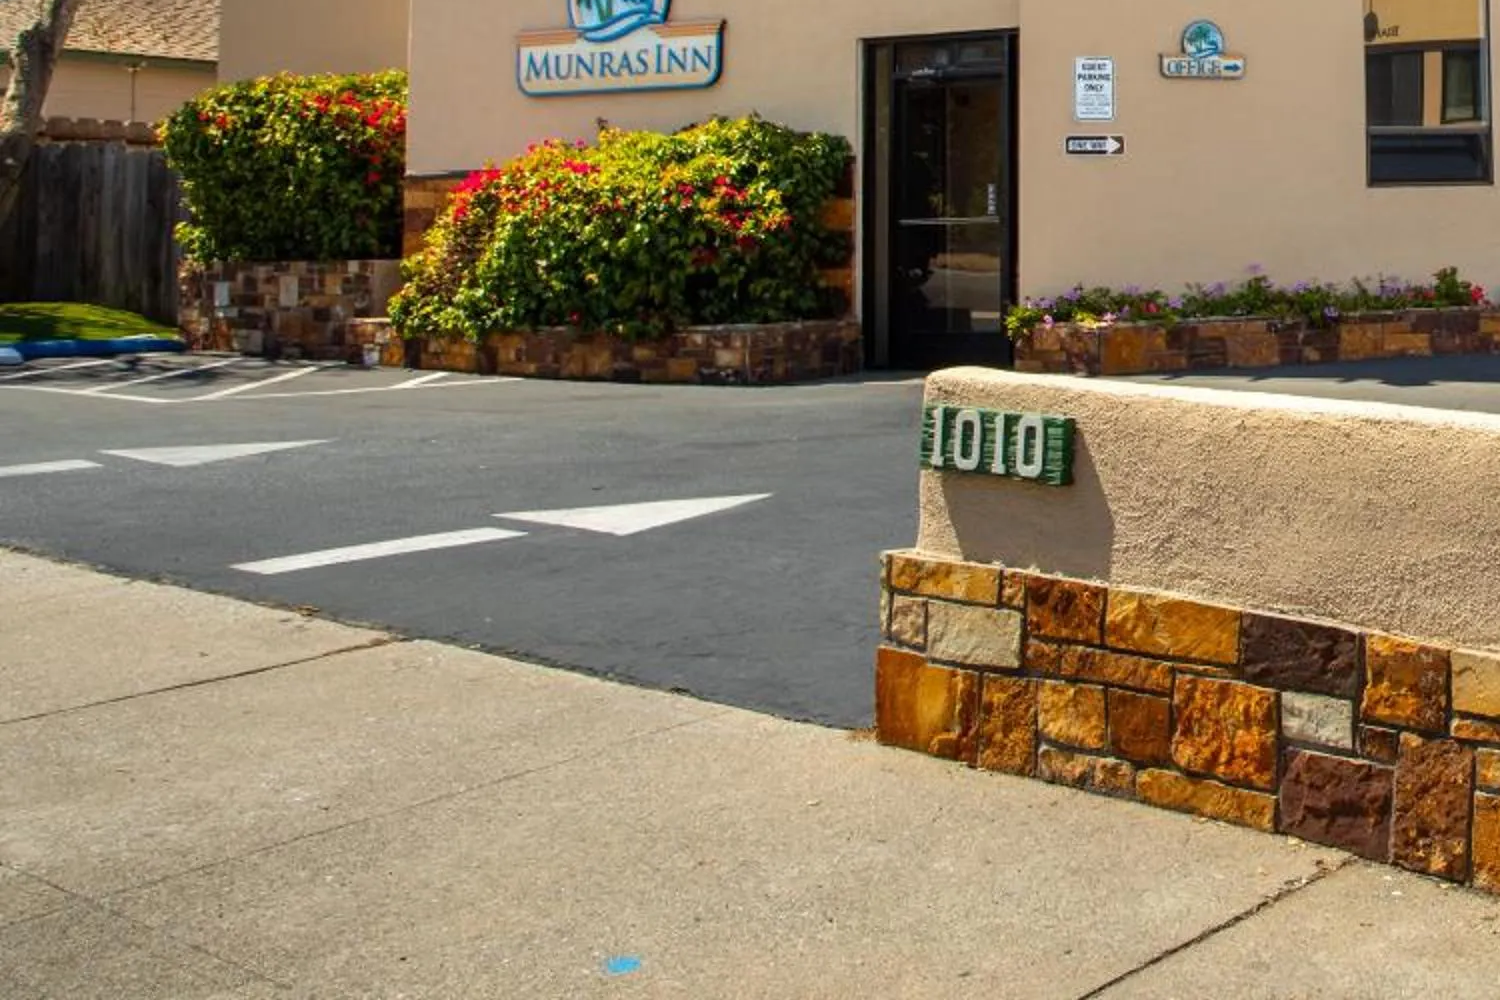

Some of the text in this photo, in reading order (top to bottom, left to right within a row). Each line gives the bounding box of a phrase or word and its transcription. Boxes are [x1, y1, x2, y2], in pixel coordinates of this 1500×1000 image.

[525, 43, 713, 81] MUNRAS INN
[1167, 59, 1222, 74] OFFICE
[930, 408, 1044, 478] 1010
